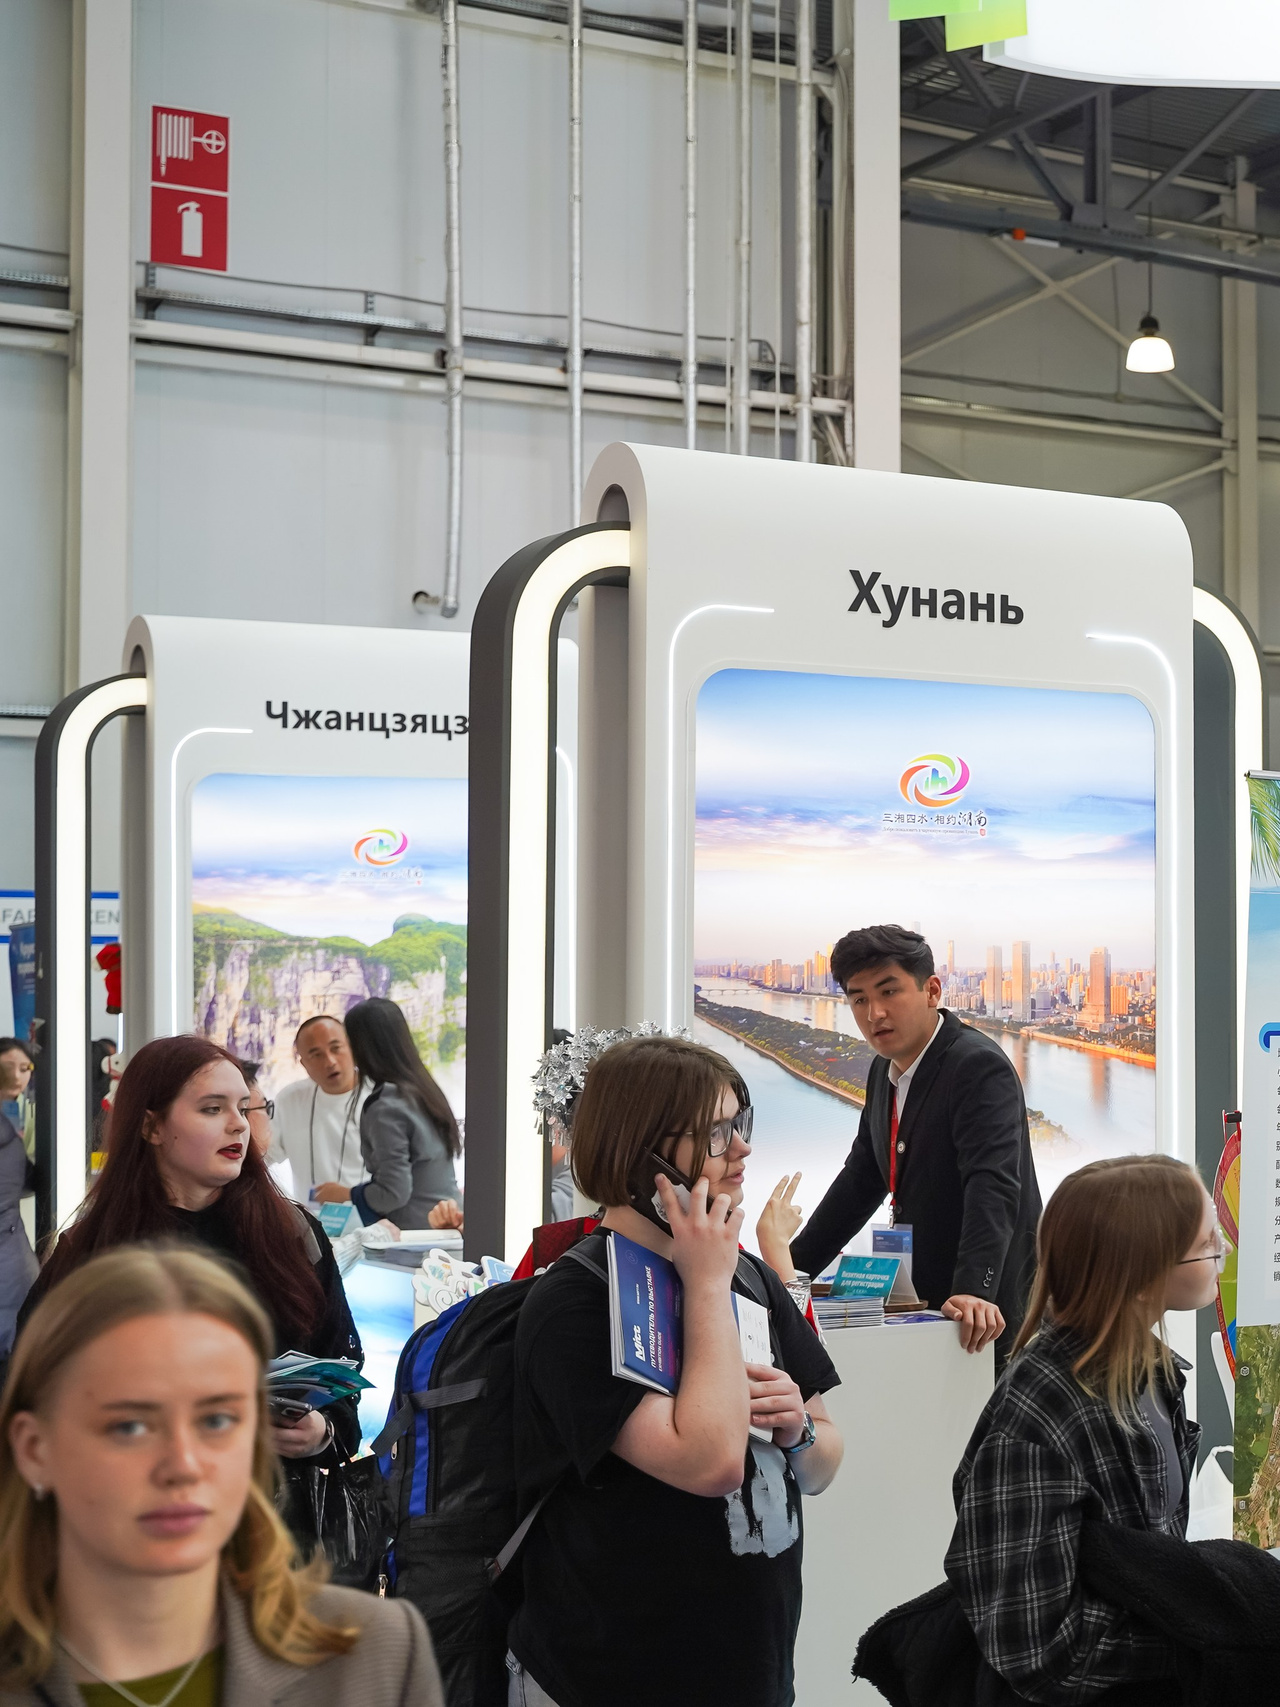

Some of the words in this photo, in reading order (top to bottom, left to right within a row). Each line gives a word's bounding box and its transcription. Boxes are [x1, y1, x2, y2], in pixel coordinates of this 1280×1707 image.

[847, 568, 1024, 629] Хунань
[265, 700, 469, 741] Чжанцзяцз
[645, 1265, 655, 1300] ВЫСТАВКЕ
[648, 1300, 655, 1312] ПО
[648, 1312, 657, 1369] ПУТЕВОДИТЕЛЬ
